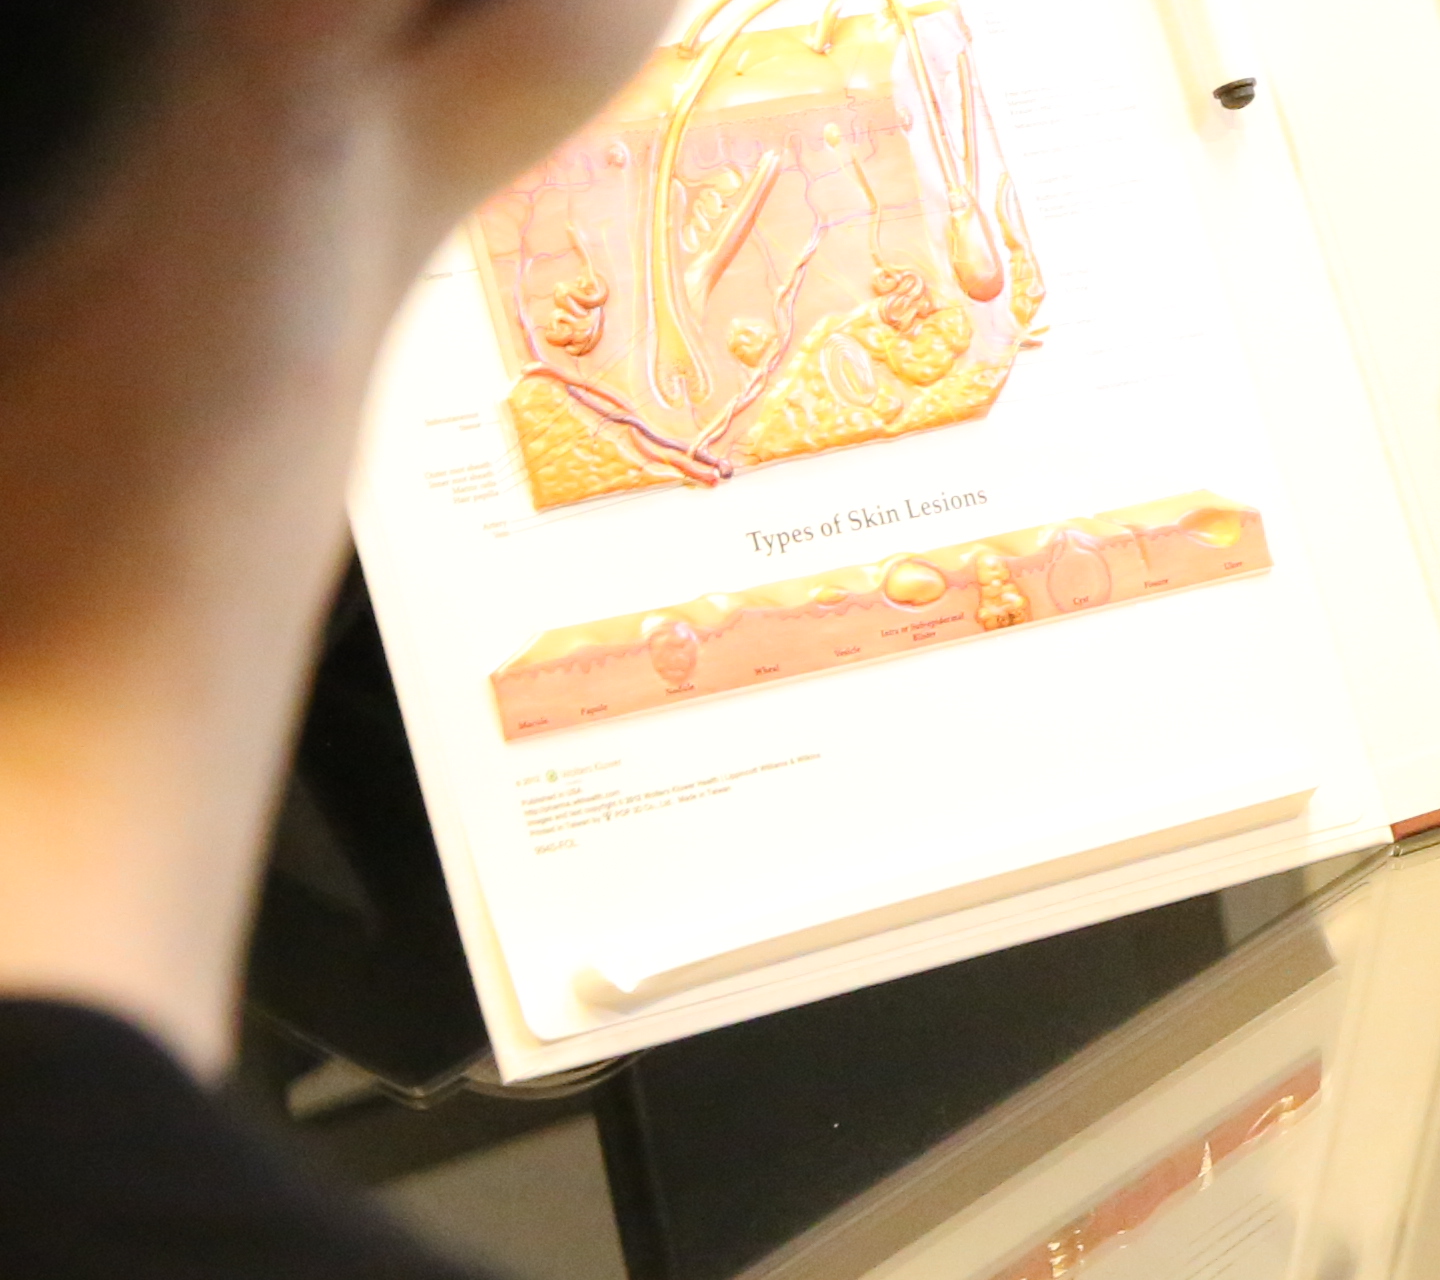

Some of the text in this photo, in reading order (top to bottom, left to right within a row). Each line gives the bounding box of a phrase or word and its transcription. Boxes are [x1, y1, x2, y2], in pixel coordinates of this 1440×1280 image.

[746, 487, 989, 558] Types of Skin Lesions
